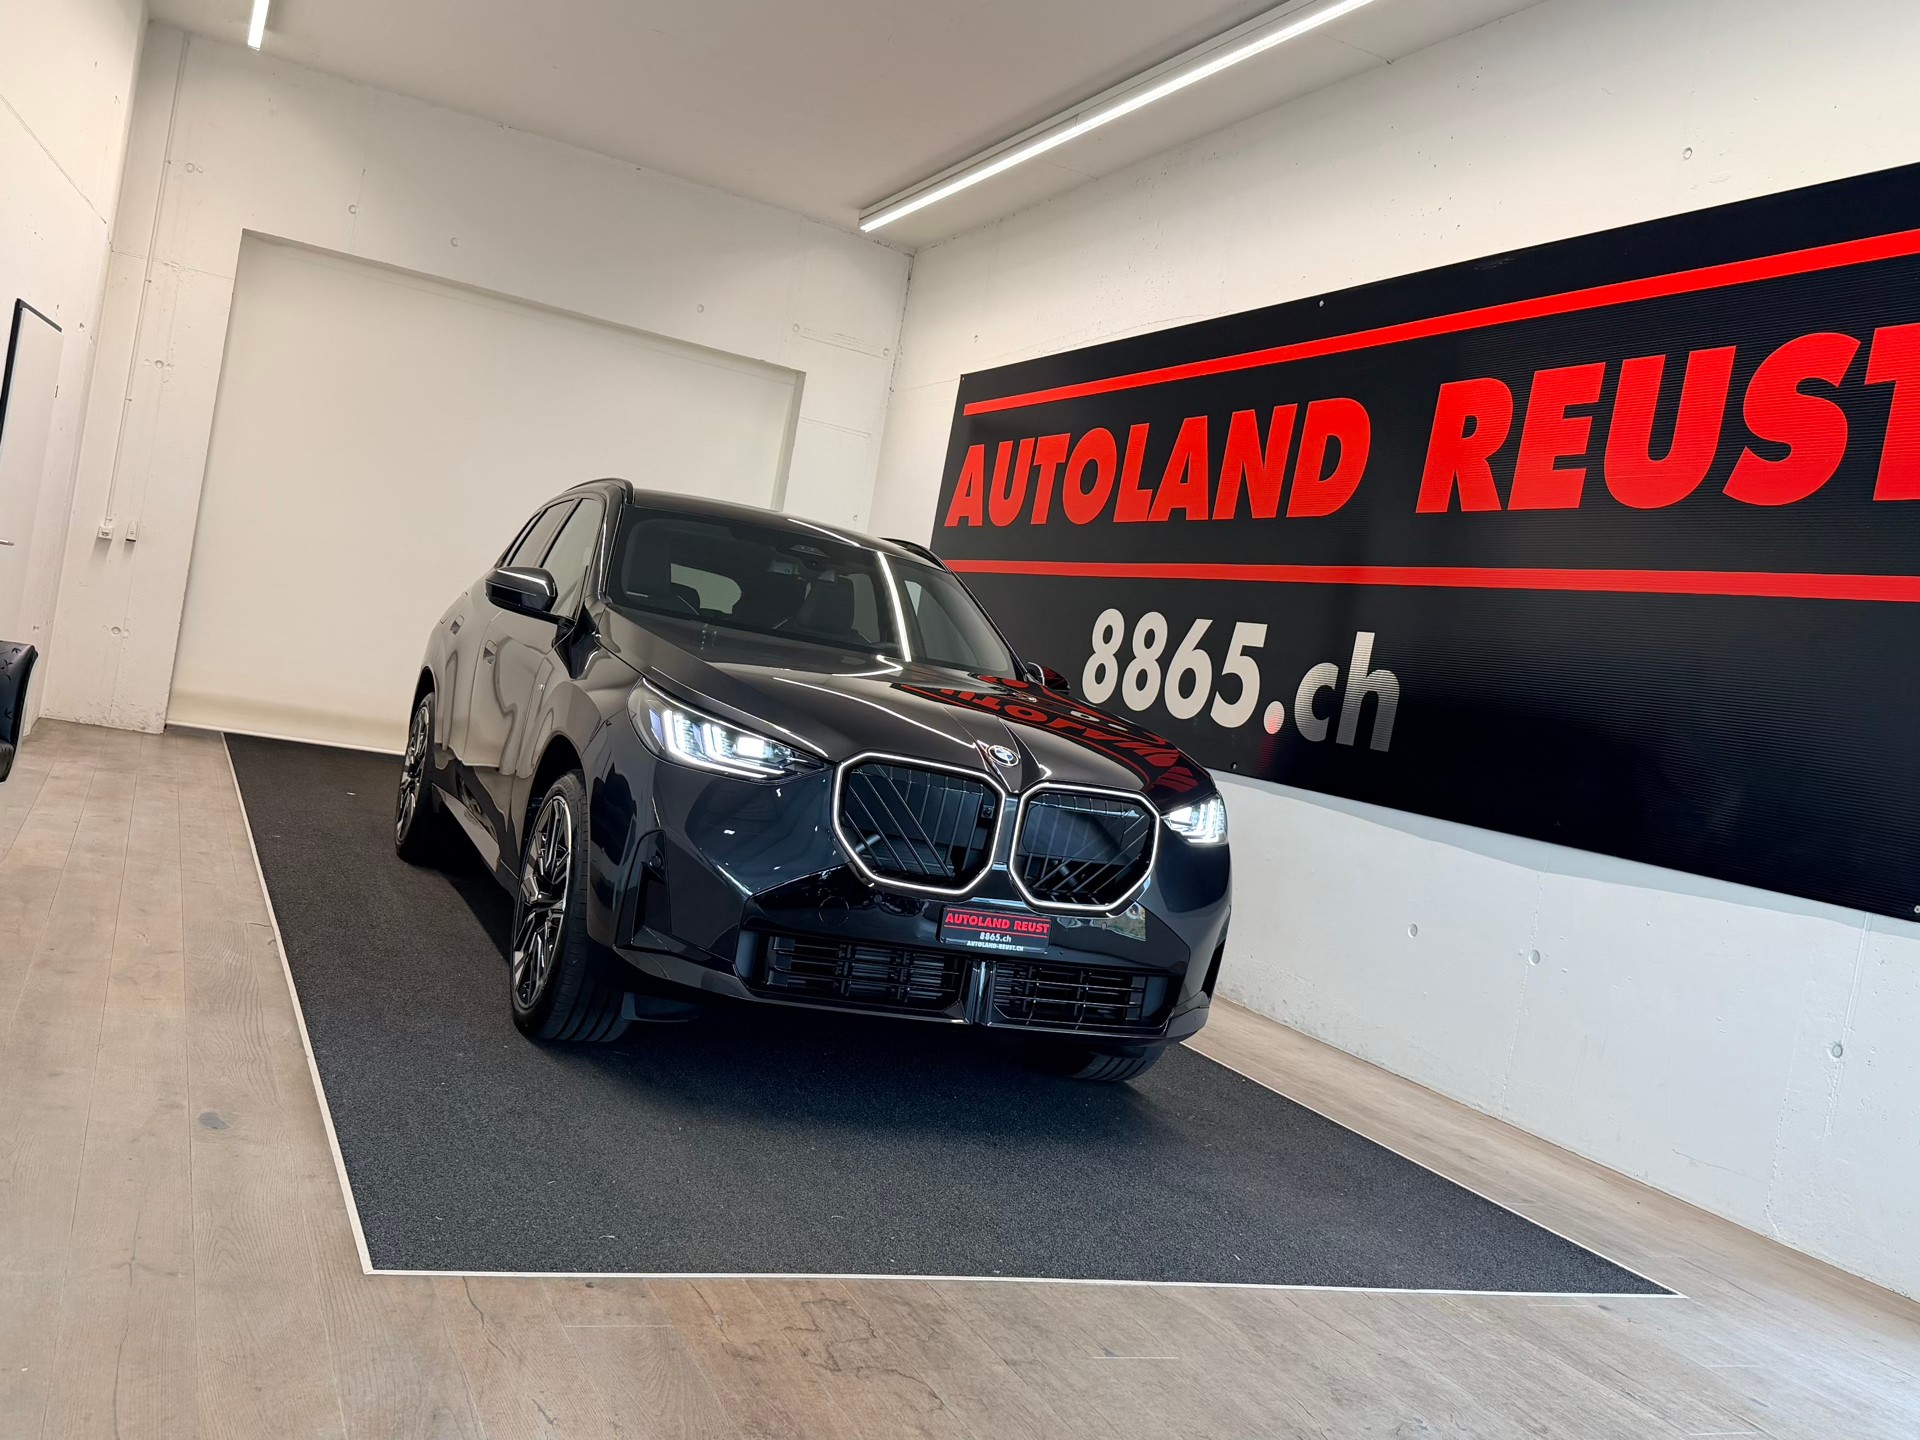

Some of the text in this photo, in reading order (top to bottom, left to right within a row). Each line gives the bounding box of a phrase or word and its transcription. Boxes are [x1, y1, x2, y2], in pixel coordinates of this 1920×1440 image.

[944, 397, 1371, 527] AUTOLAND
[1082, 608, 1400, 752] 8865.ch
[945, 913, 1050, 933] AUTOLAND REUST
[966, 940, 1024, 952] AUTOLAND-REUST.CH
[979, 932, 1012, 943] 8865.ch
